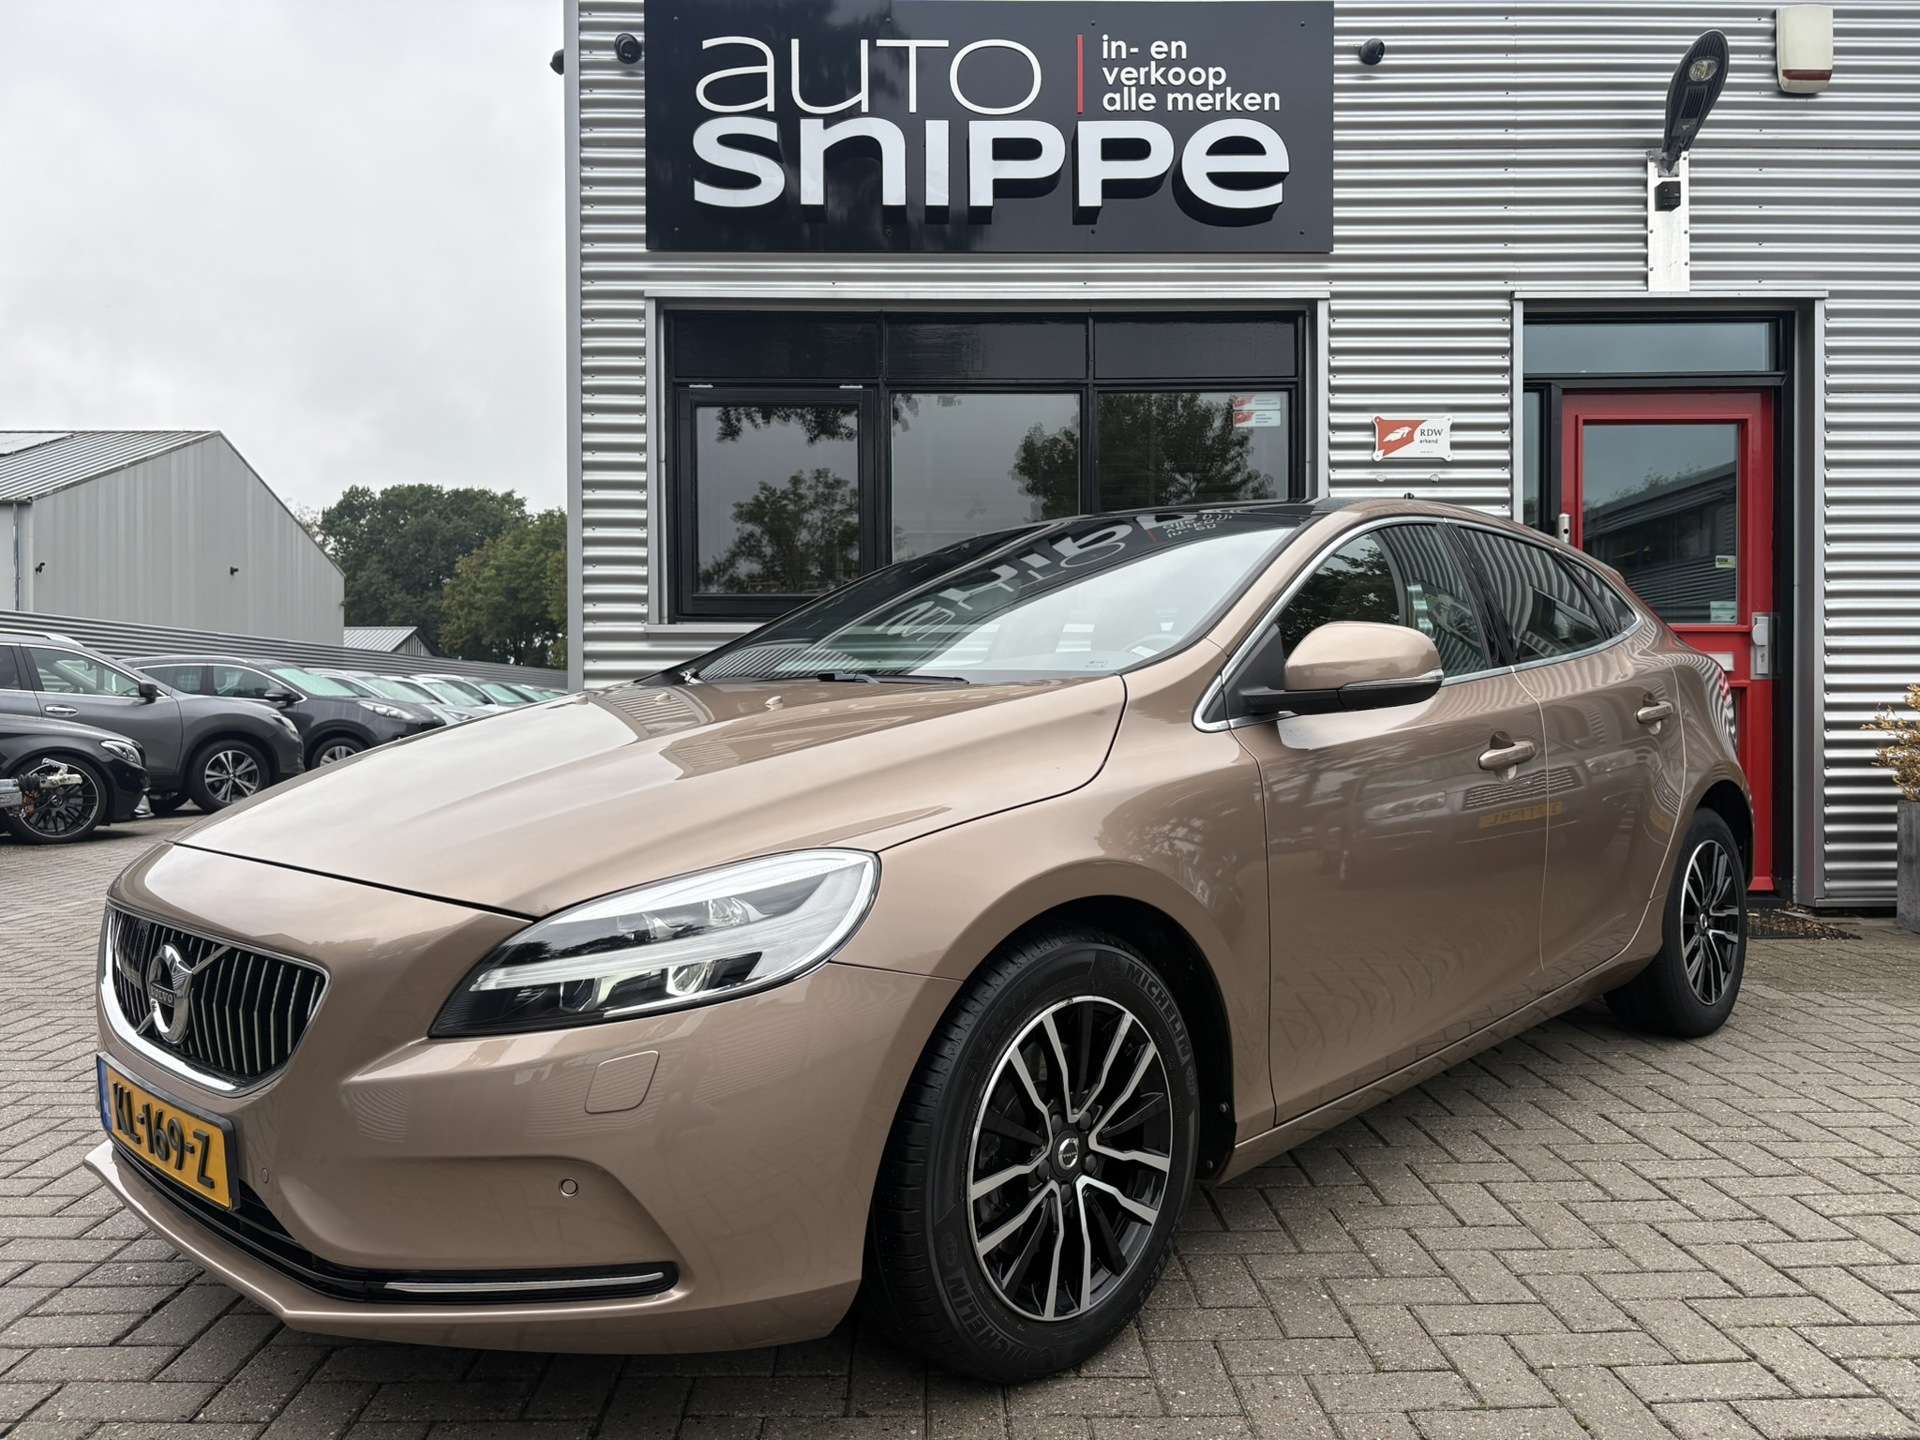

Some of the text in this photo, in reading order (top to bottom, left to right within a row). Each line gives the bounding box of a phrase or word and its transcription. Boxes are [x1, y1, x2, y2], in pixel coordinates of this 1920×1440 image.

[1102, 33, 1187, 60] in- en
[1102, 60, 1227, 91] verkoop
[1102, 86, 1280, 112] alle merken
[1420, 428, 1443, 437] RDW
[113, 1082, 215, 1189] KL-169-Z
